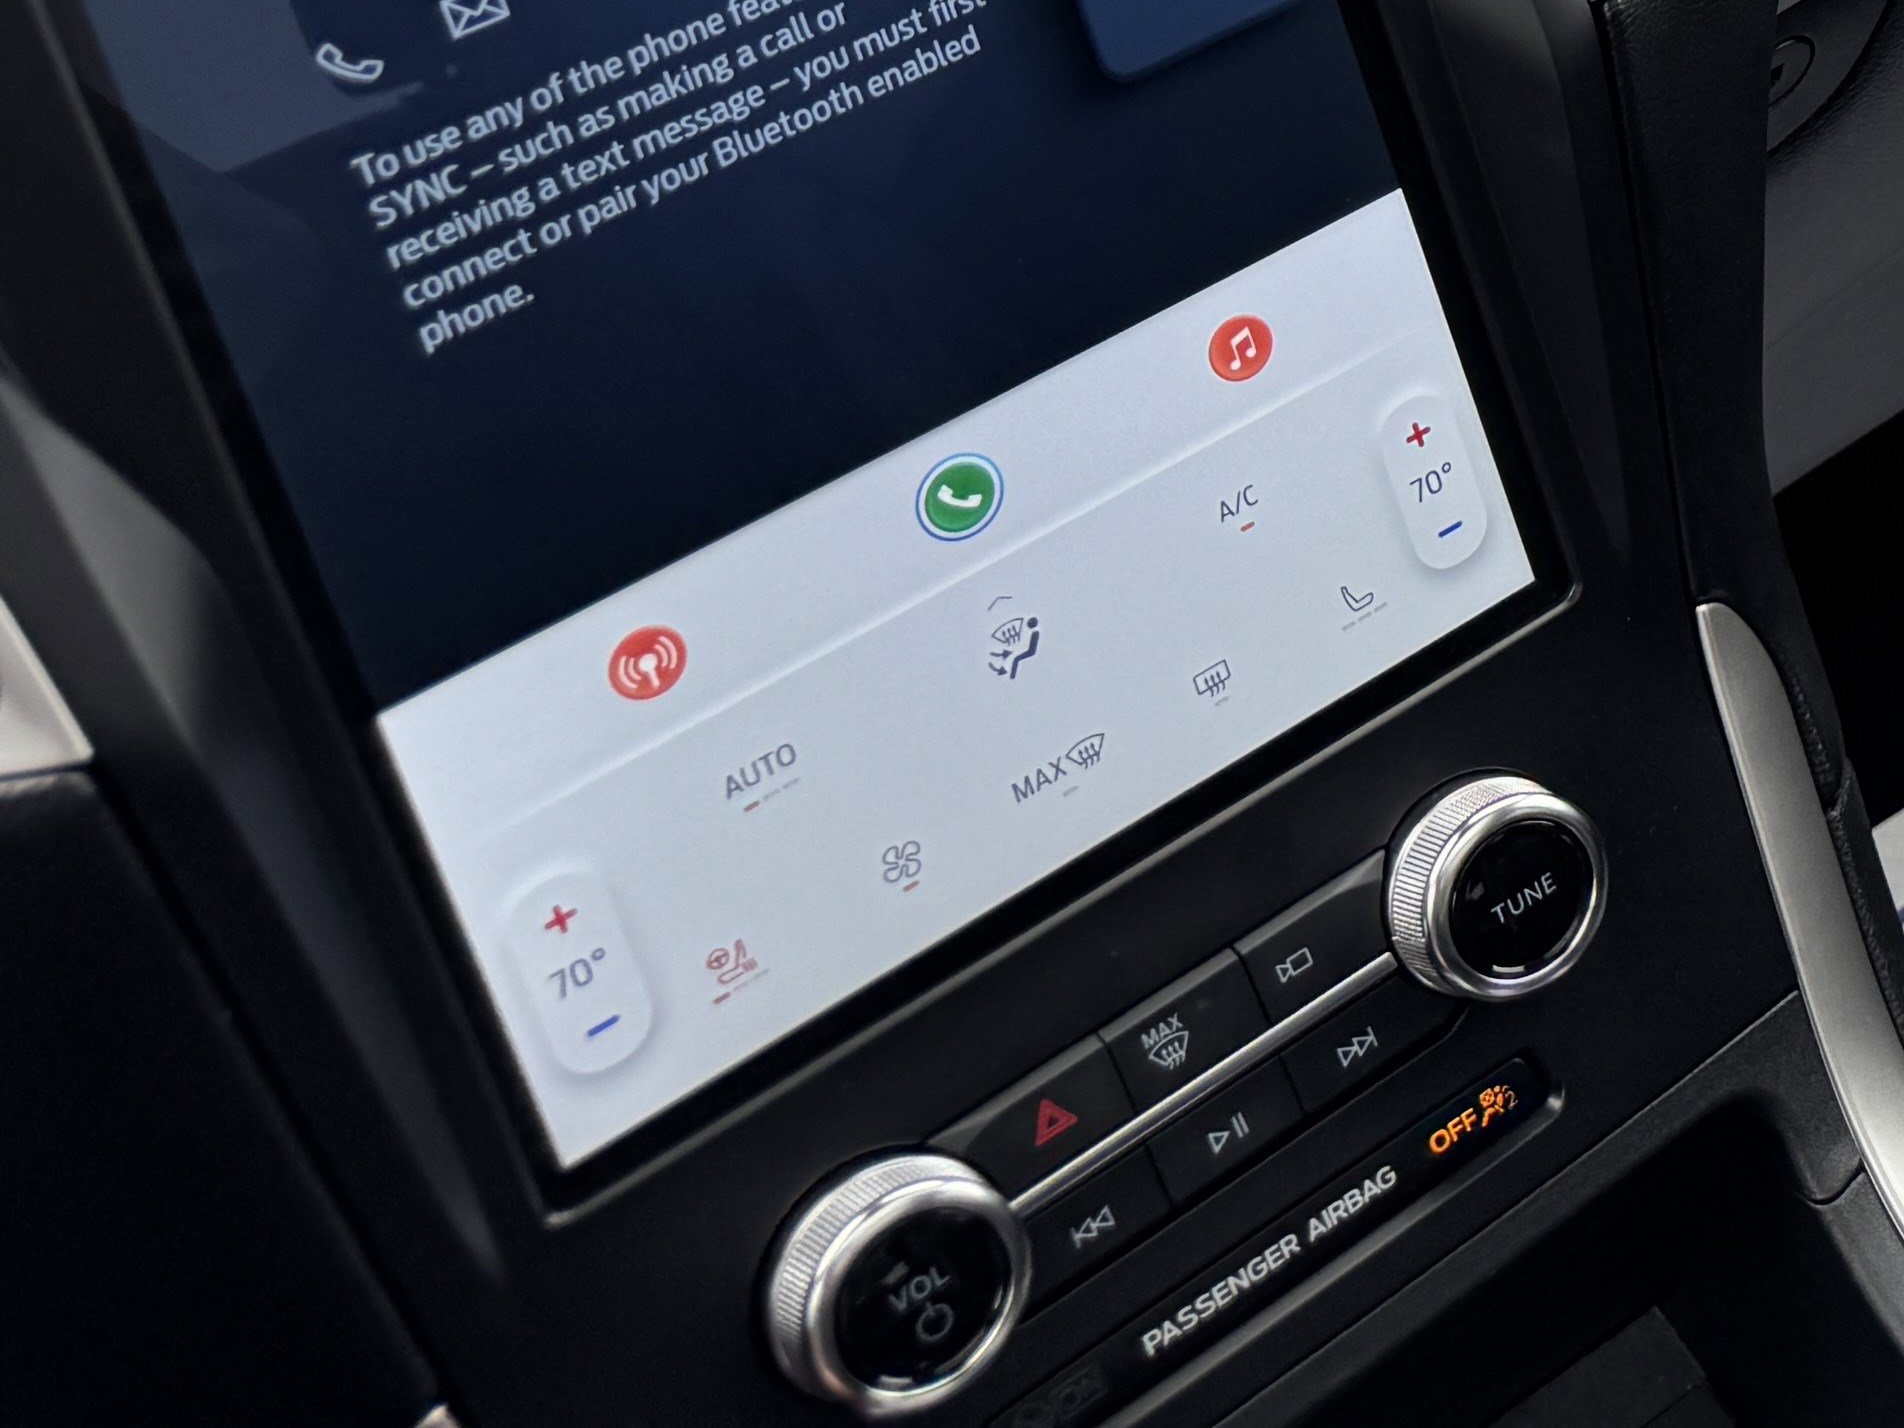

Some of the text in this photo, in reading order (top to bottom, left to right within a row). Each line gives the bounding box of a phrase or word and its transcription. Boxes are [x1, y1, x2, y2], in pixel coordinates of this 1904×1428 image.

[350, 153, 400, 186] To
[402, 126, 464, 166] use
[466, 97, 525, 140] any
[530, 72, 564, 112] of
[568, 60, 625, 95] the
[627, 24, 727, 76] phone
[368, 164, 468, 228] SYNC
[498, 121, 575, 174] such
[577, 105, 616, 138] as
[617, 53, 735, 121] making
[736, 44, 758, 69] a
[760, 12, 815, 58] call
[816, 2, 845, 32] or
[386, 185, 536, 270] receiving
[537, 176, 561, 202] a
[561, 140, 631, 191] text
[632, 84, 766, 160] message
[793, 44, 850, 92] you
[852, 8, 928, 61] must
[402, 23, 983, 310] connect or pair your Bluetooth enabled
[418, 283, 536, 356] phone.
[1219, 484, 1260, 524] A/C
[1408, 461, 1453, 504] 70°
[723, 743, 799, 801] AUTO
[1010, 755, 1069, 804] MAX
[1490, 872, 1557, 924] TUNE
[547, 947, 606, 1001] 70°
[1141, 1012, 1183, 1050] MAX
[1141, 1232, 1301, 1357] PASSENGER
[1307, 1164, 1398, 1242] AIRBAG
[1429, 1107, 1477, 1156] OFF
[888, 1265, 951, 1313] VOL
